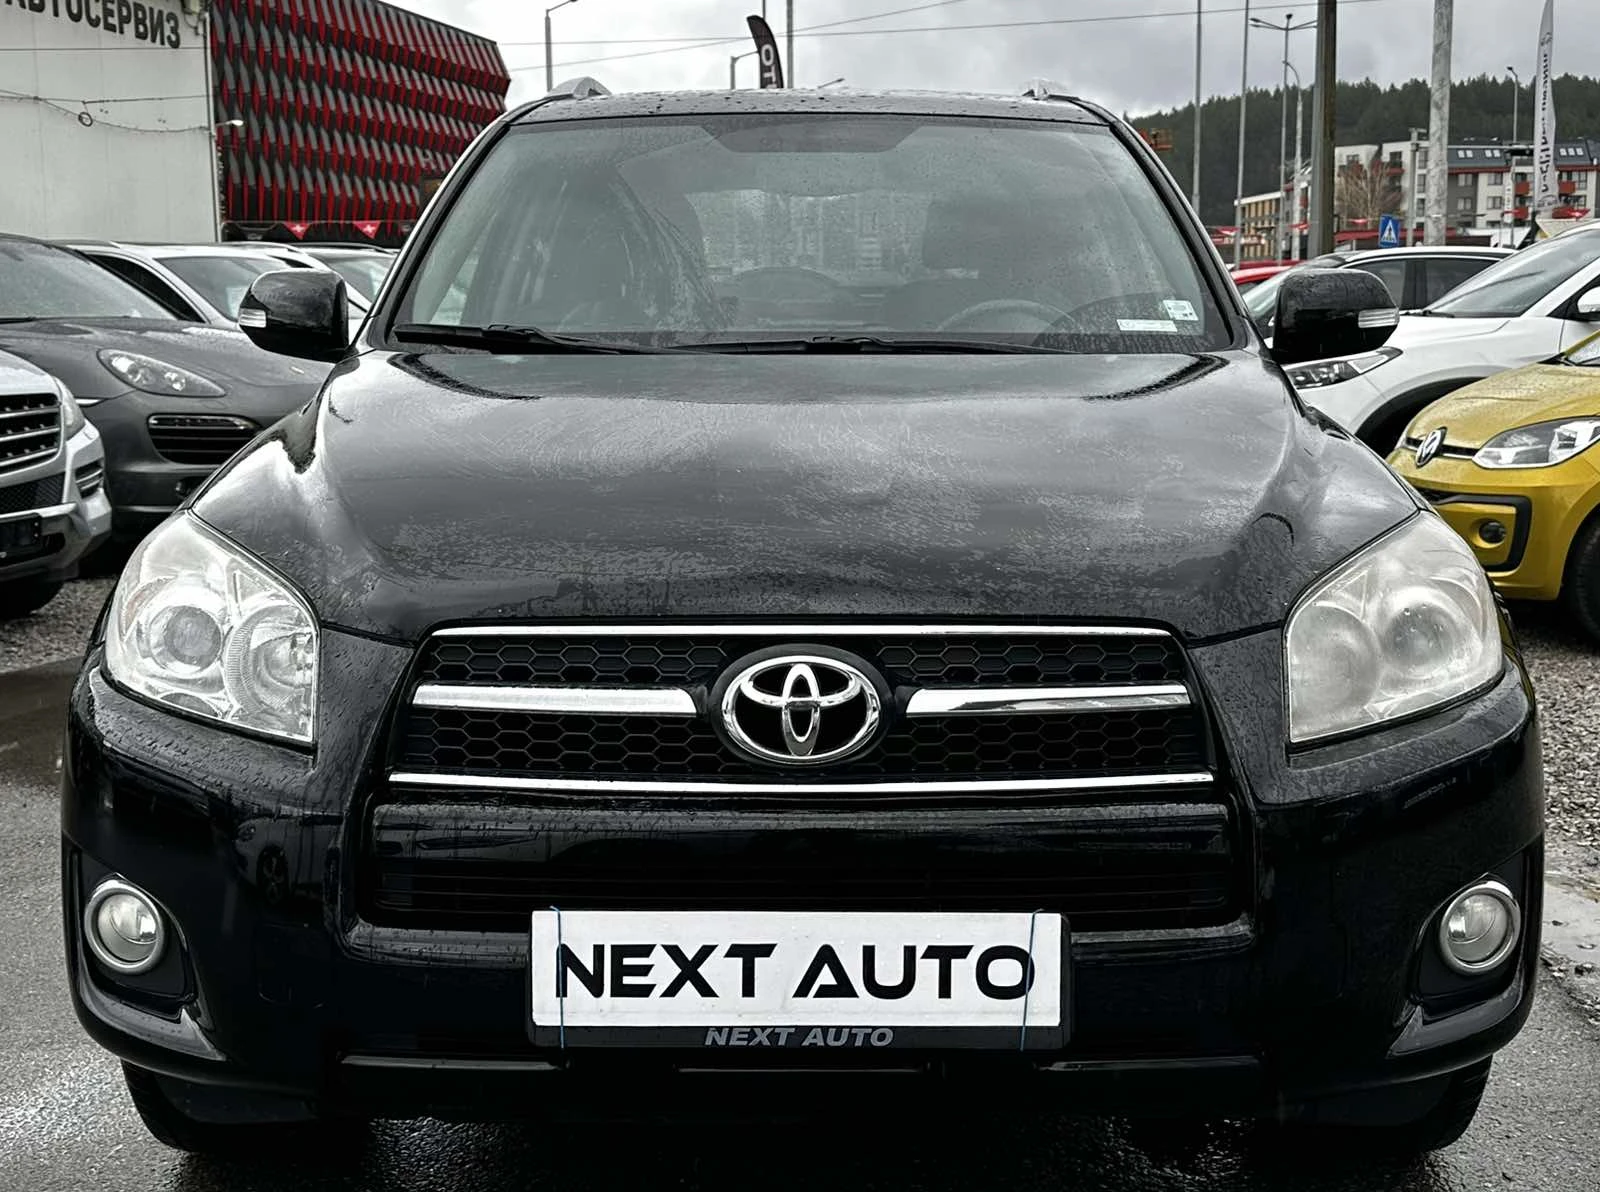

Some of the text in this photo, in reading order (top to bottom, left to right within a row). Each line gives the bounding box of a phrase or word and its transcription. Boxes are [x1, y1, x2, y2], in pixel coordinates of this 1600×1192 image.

[5, 0, 181, 49] ОСЕРВИЗ
[555, 943, 1035, 1000] NEXT AUTO
[705, 1028, 894, 1047] NEXT AUTO
